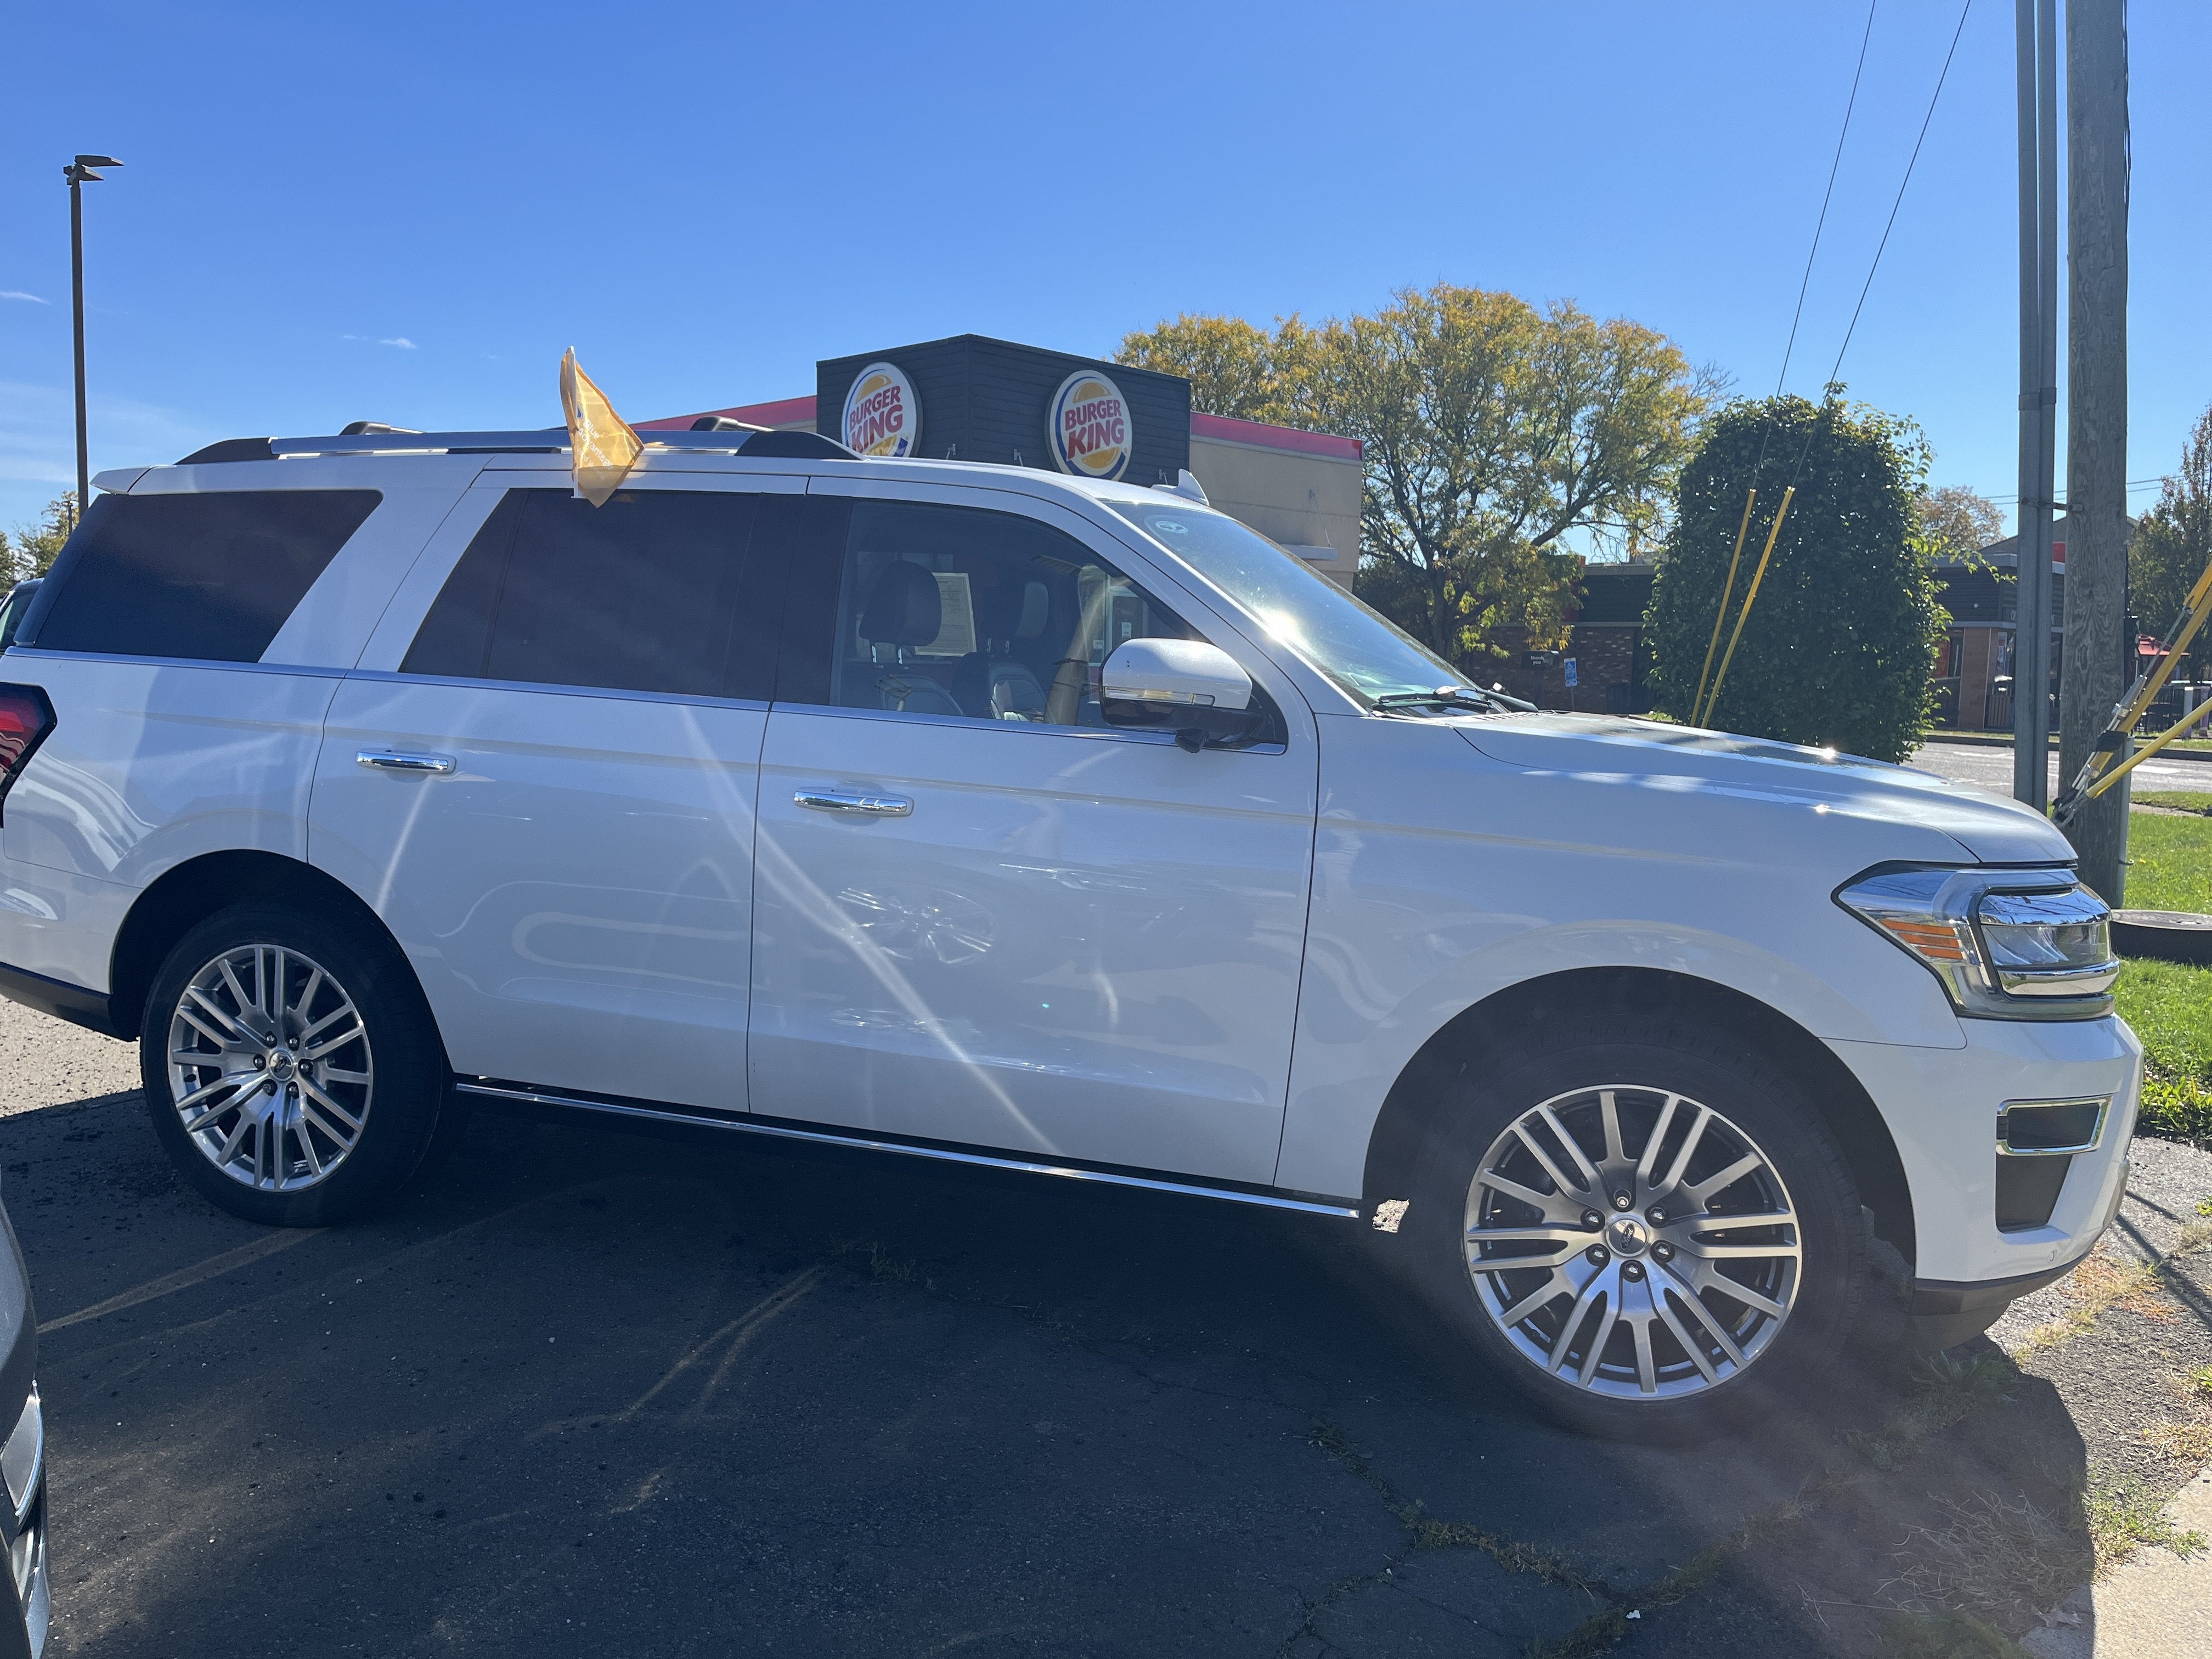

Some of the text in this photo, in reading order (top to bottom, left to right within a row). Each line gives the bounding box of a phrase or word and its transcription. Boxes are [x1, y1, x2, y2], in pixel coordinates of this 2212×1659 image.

[850, 386, 901, 433] BURGER
[851, 404, 903, 453] KING
[1065, 399, 1121, 431] BURGER
[1068, 417, 1124, 460] KING
